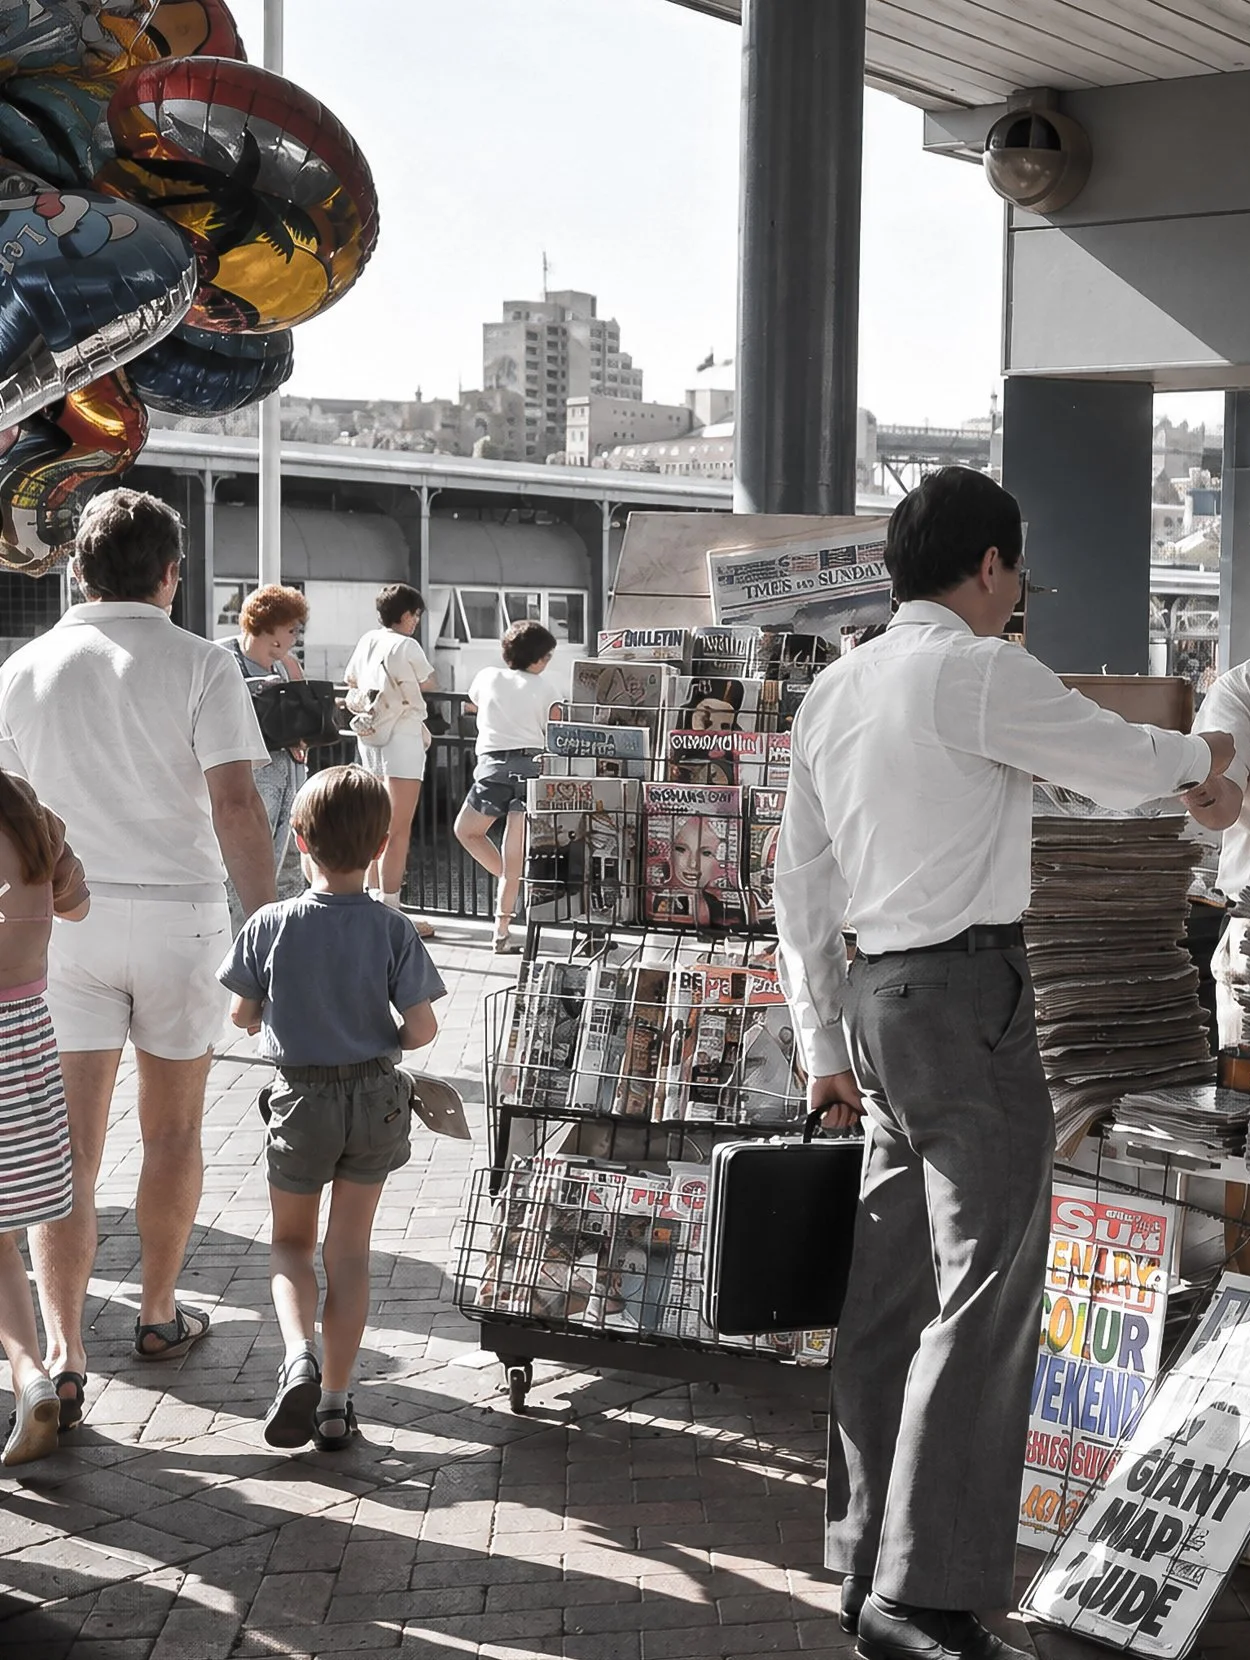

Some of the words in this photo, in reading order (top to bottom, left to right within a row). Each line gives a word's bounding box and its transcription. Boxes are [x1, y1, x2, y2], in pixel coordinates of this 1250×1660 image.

[817, 561, 886, 587] SUNDAY
[755, 792, 779, 808] TV
[1087, 1496, 1184, 1563] MAP
